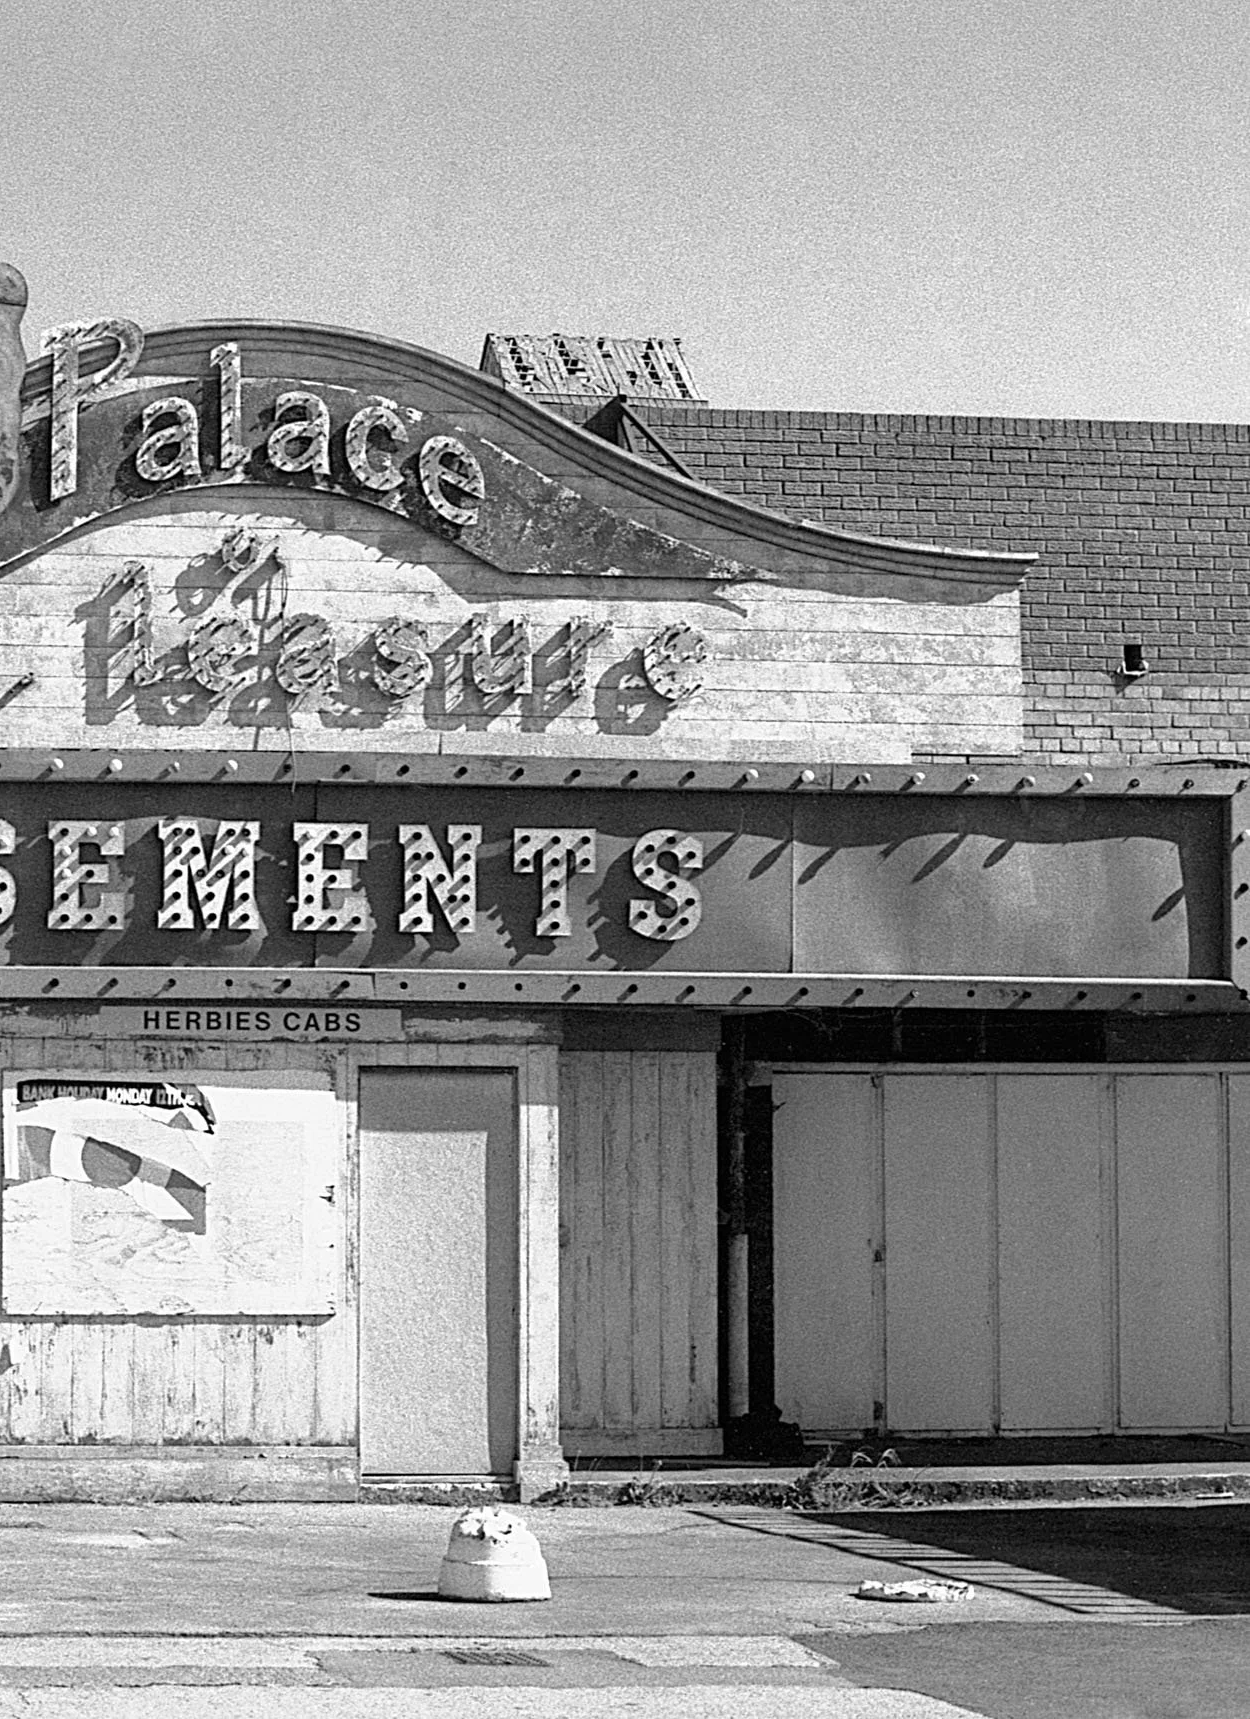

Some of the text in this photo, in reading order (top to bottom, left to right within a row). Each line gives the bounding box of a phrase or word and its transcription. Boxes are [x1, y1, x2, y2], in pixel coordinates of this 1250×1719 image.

[42, 317, 485, 525] Palace
[144, 1011, 361, 1032] HERBIES CABS
[22, 1084, 55, 1101] BANK
[57, 1085, 104, 1100] HOLIDAY
[106, 1087, 153, 1105] MONDAY
